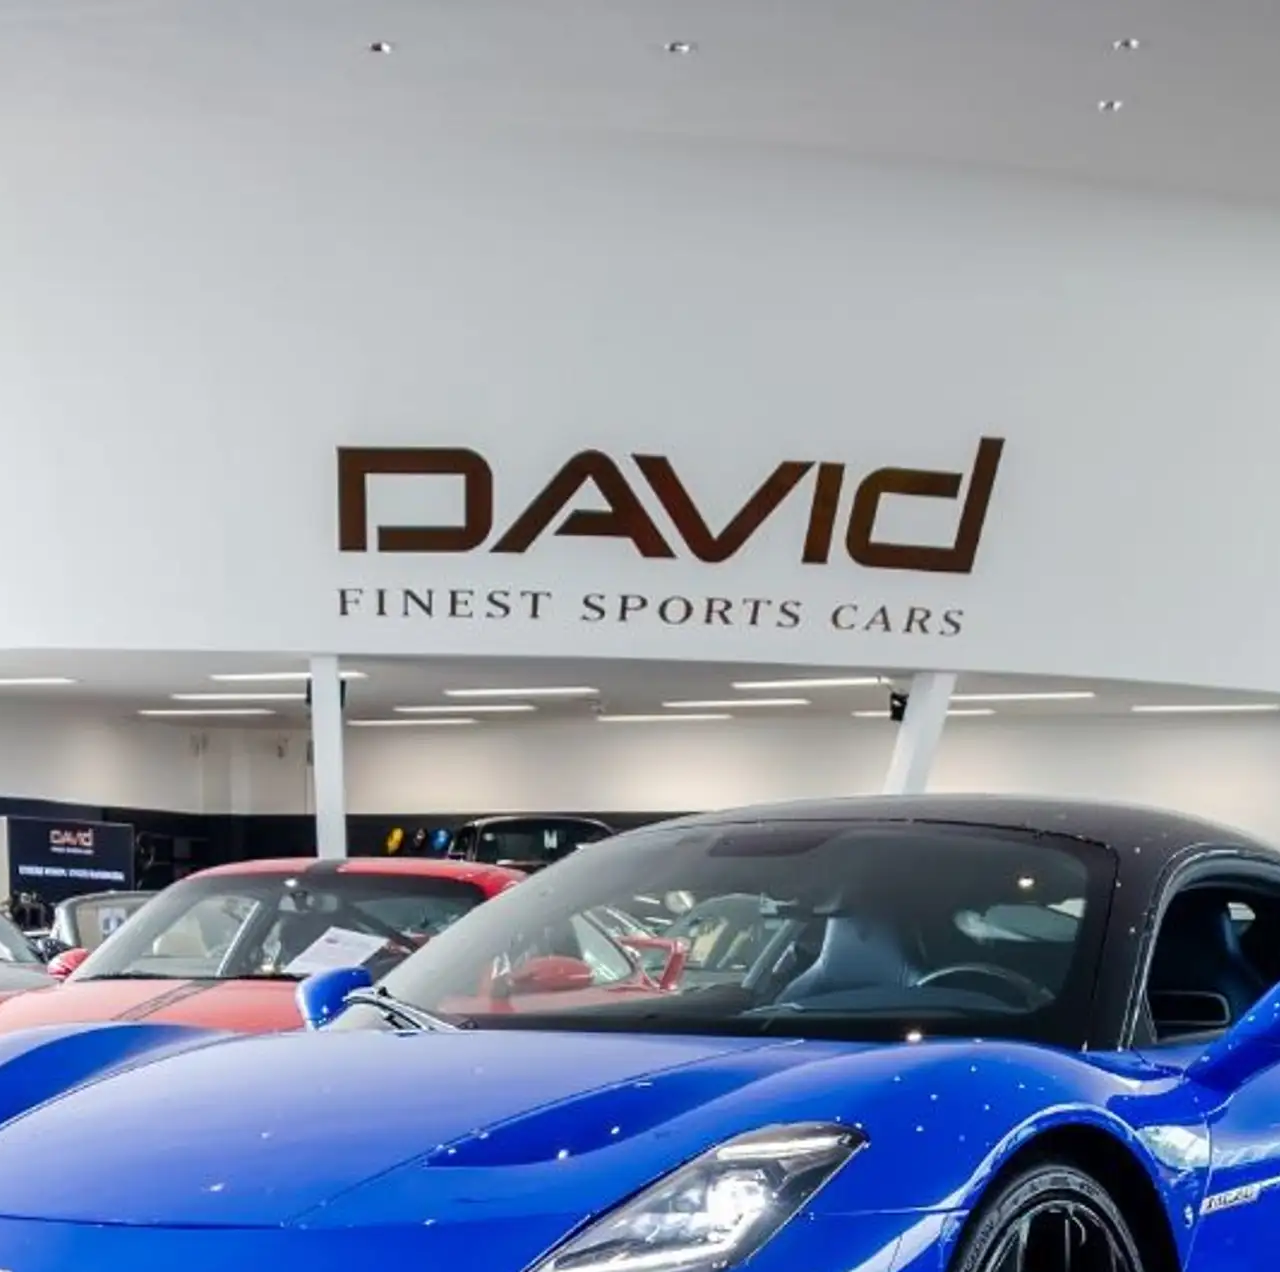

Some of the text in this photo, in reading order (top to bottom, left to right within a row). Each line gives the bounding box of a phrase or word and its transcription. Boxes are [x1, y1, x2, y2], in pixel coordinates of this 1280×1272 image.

[336, 588, 966, 636] FINEST SPORTS CARS
